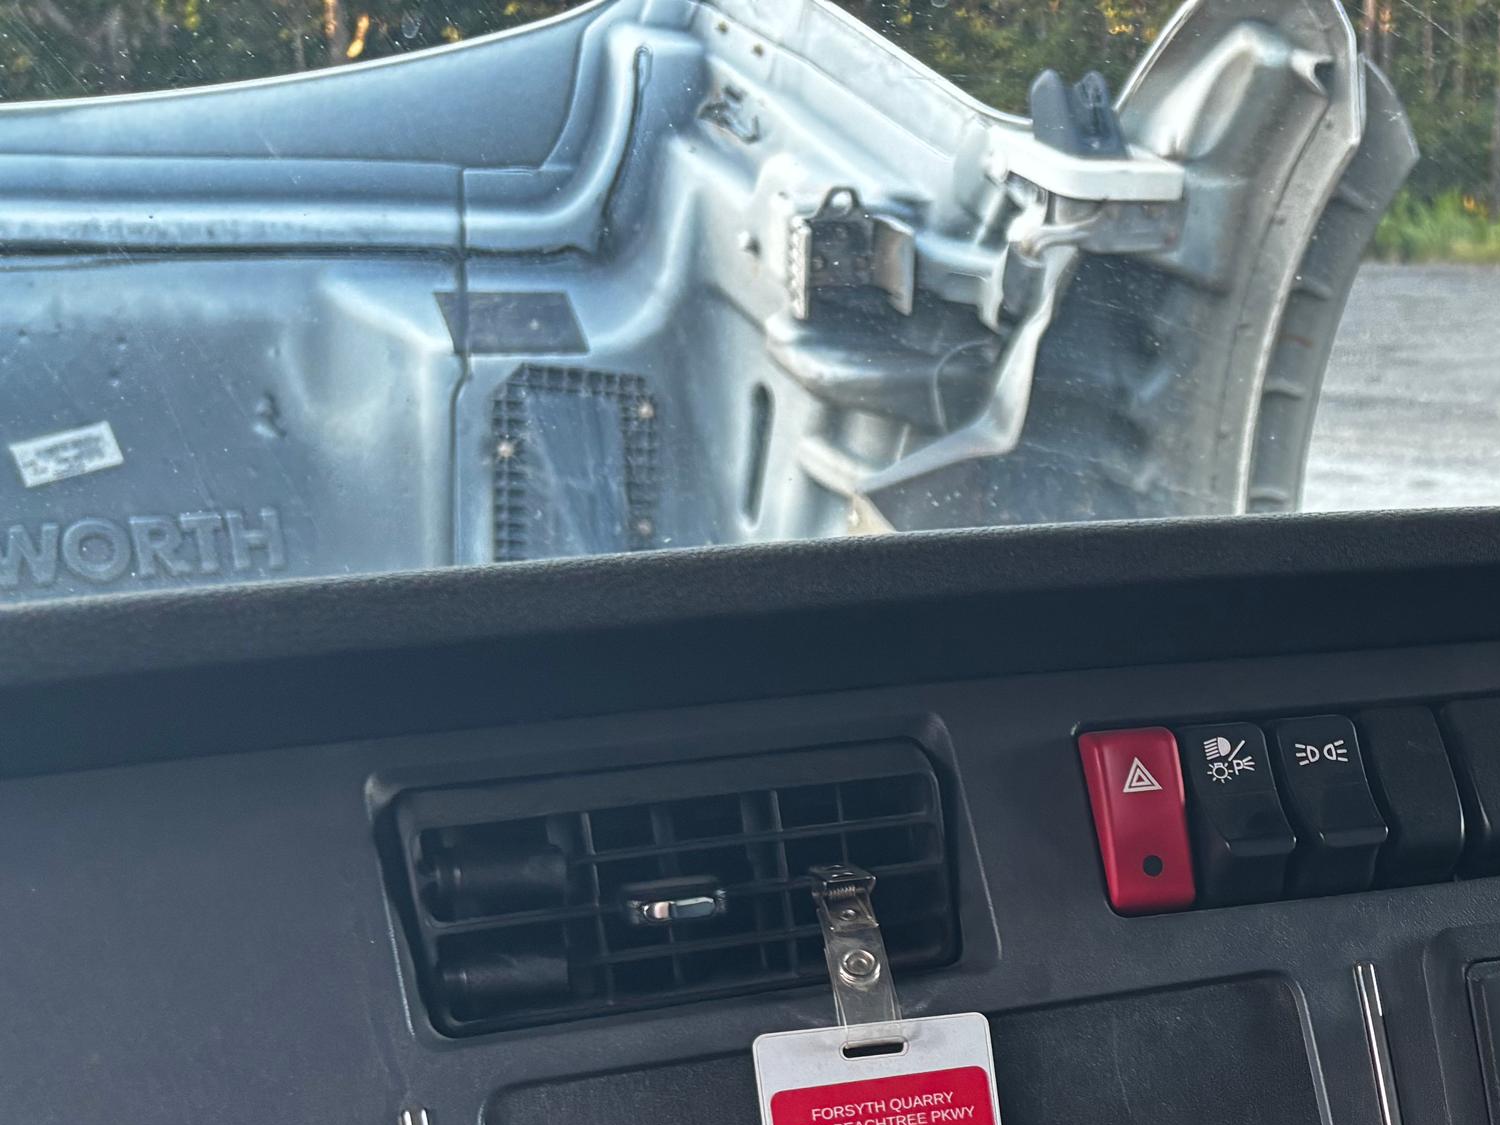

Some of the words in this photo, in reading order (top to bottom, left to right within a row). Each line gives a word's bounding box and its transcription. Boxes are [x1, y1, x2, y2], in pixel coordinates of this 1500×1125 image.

[811, 1100, 886, 1121] FORSYTH
[889, 1091, 954, 1112] QUARRY
[930, 1105, 976, 1123] PKWY
